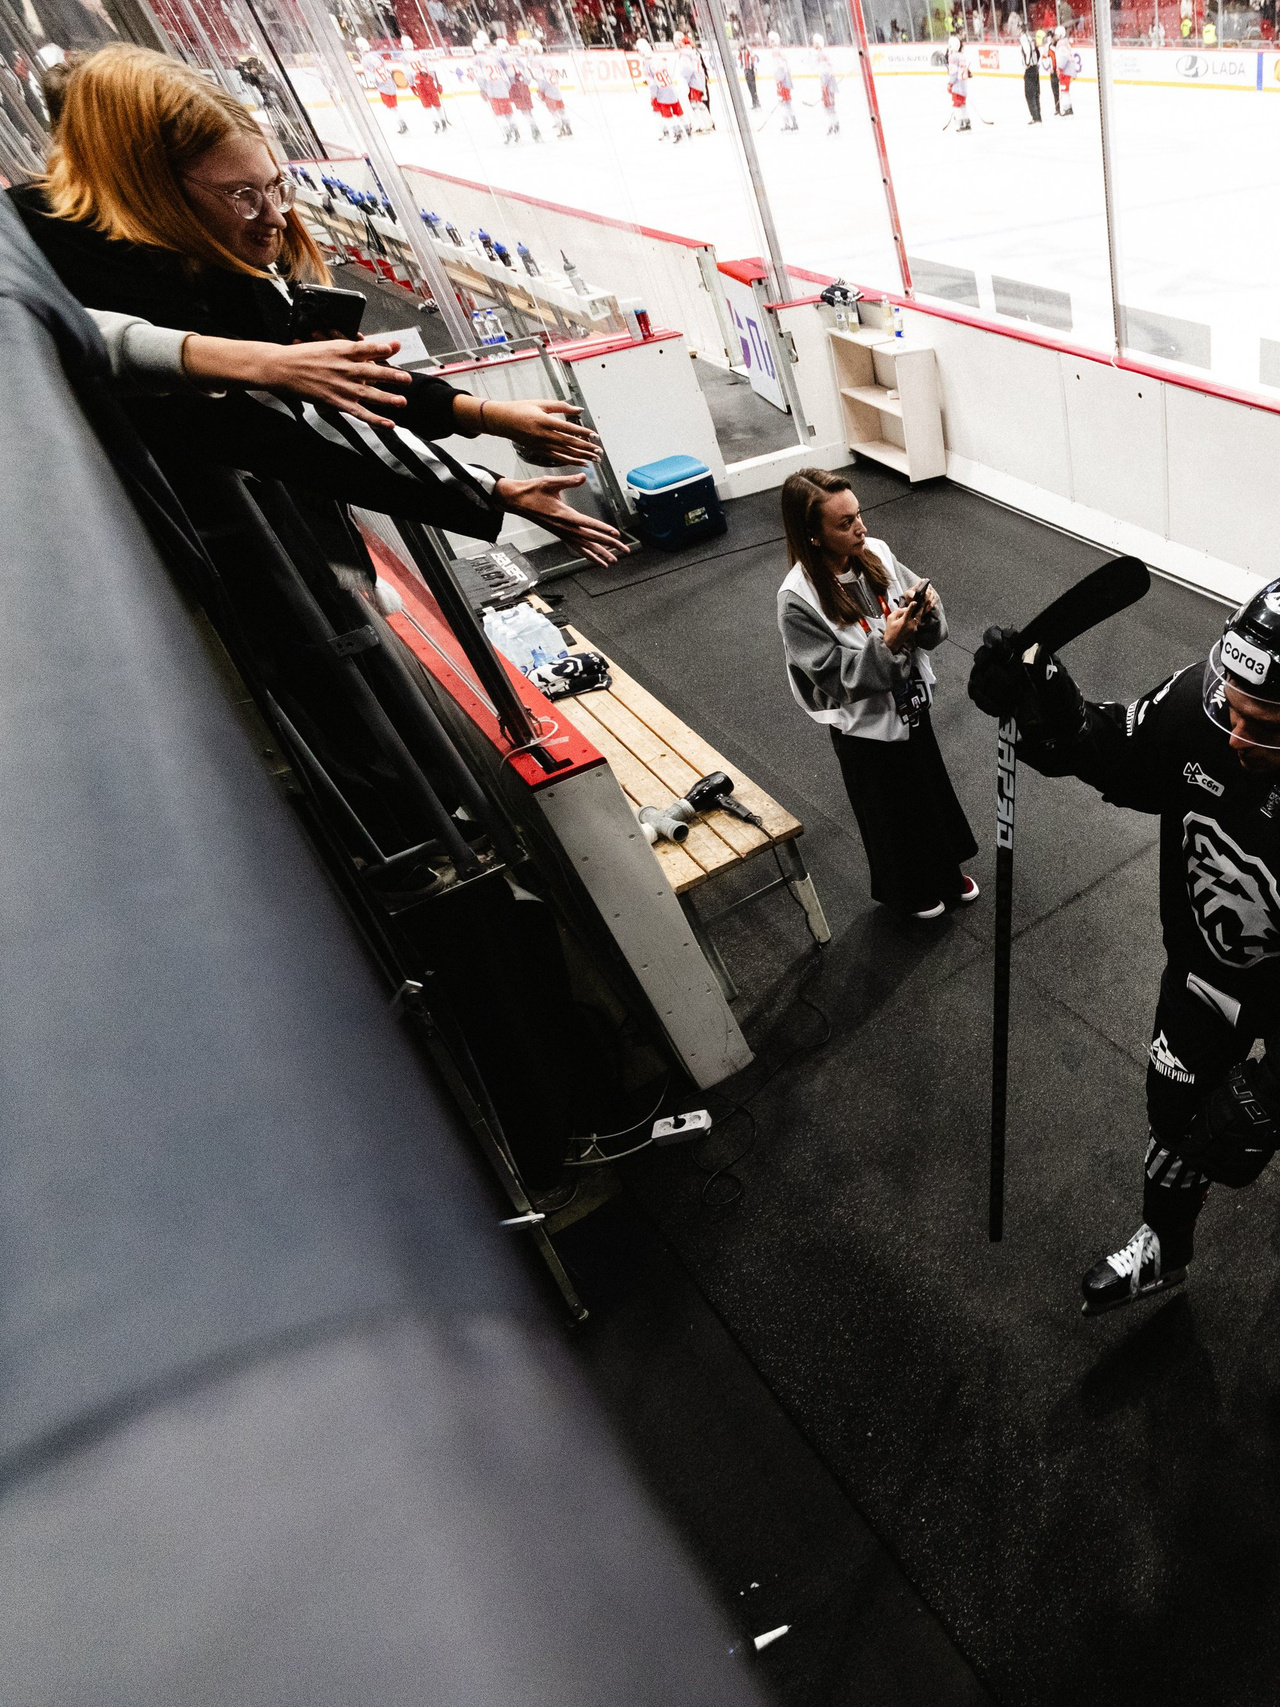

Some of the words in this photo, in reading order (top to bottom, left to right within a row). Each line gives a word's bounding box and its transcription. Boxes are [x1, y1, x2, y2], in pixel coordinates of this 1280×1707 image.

[1212, 60, 1246, 75] LADA
[1224, 641, 1266, 675] согаз
[1201, 775, 1220, 793] сбп
